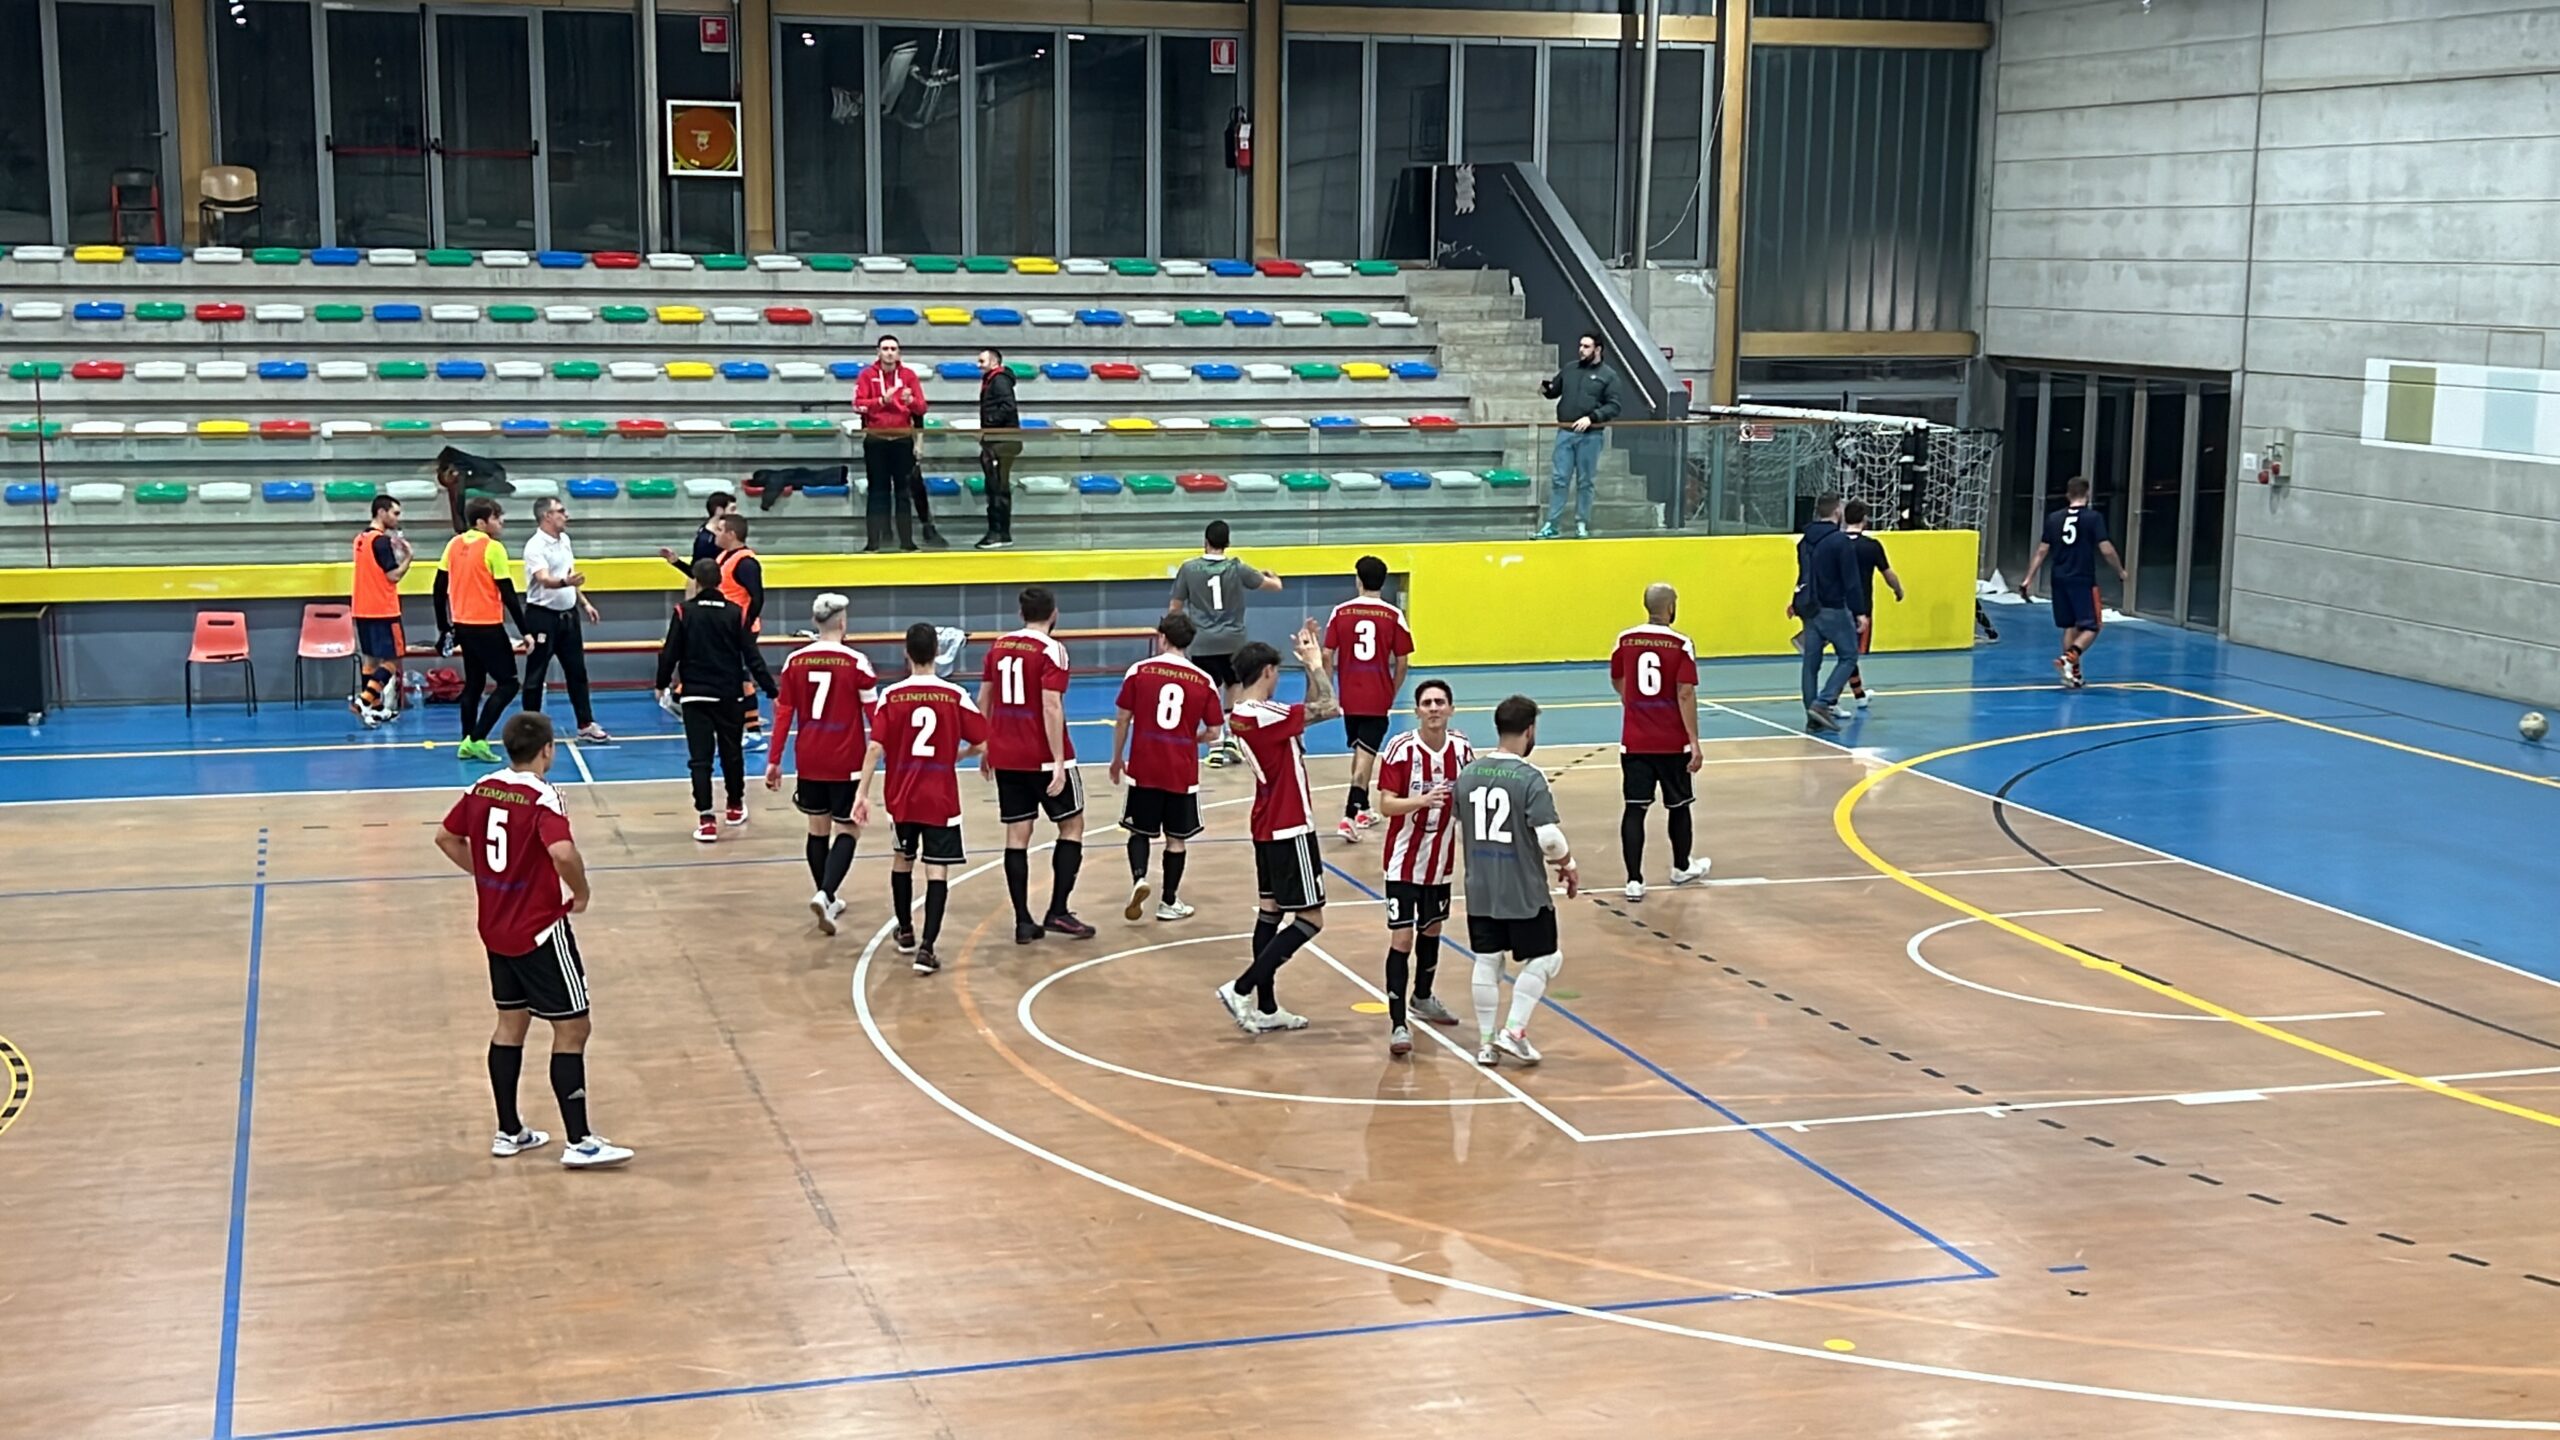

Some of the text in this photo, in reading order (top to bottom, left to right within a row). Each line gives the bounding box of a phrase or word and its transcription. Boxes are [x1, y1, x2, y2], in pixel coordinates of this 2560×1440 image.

[2061, 516, 2078, 545] 5
[1207, 575, 1223, 611] 1
[1353, 619, 1376, 661] 3
[808, 671, 832, 720] 7
[997, 655, 1025, 705] 11
[1637, 651, 1662, 697] 6
[1156, 683, 1185, 730] 8
[911, 706, 937, 757] 2
[1469, 786, 1513, 844] 12
[486, 807, 509, 873] 5
